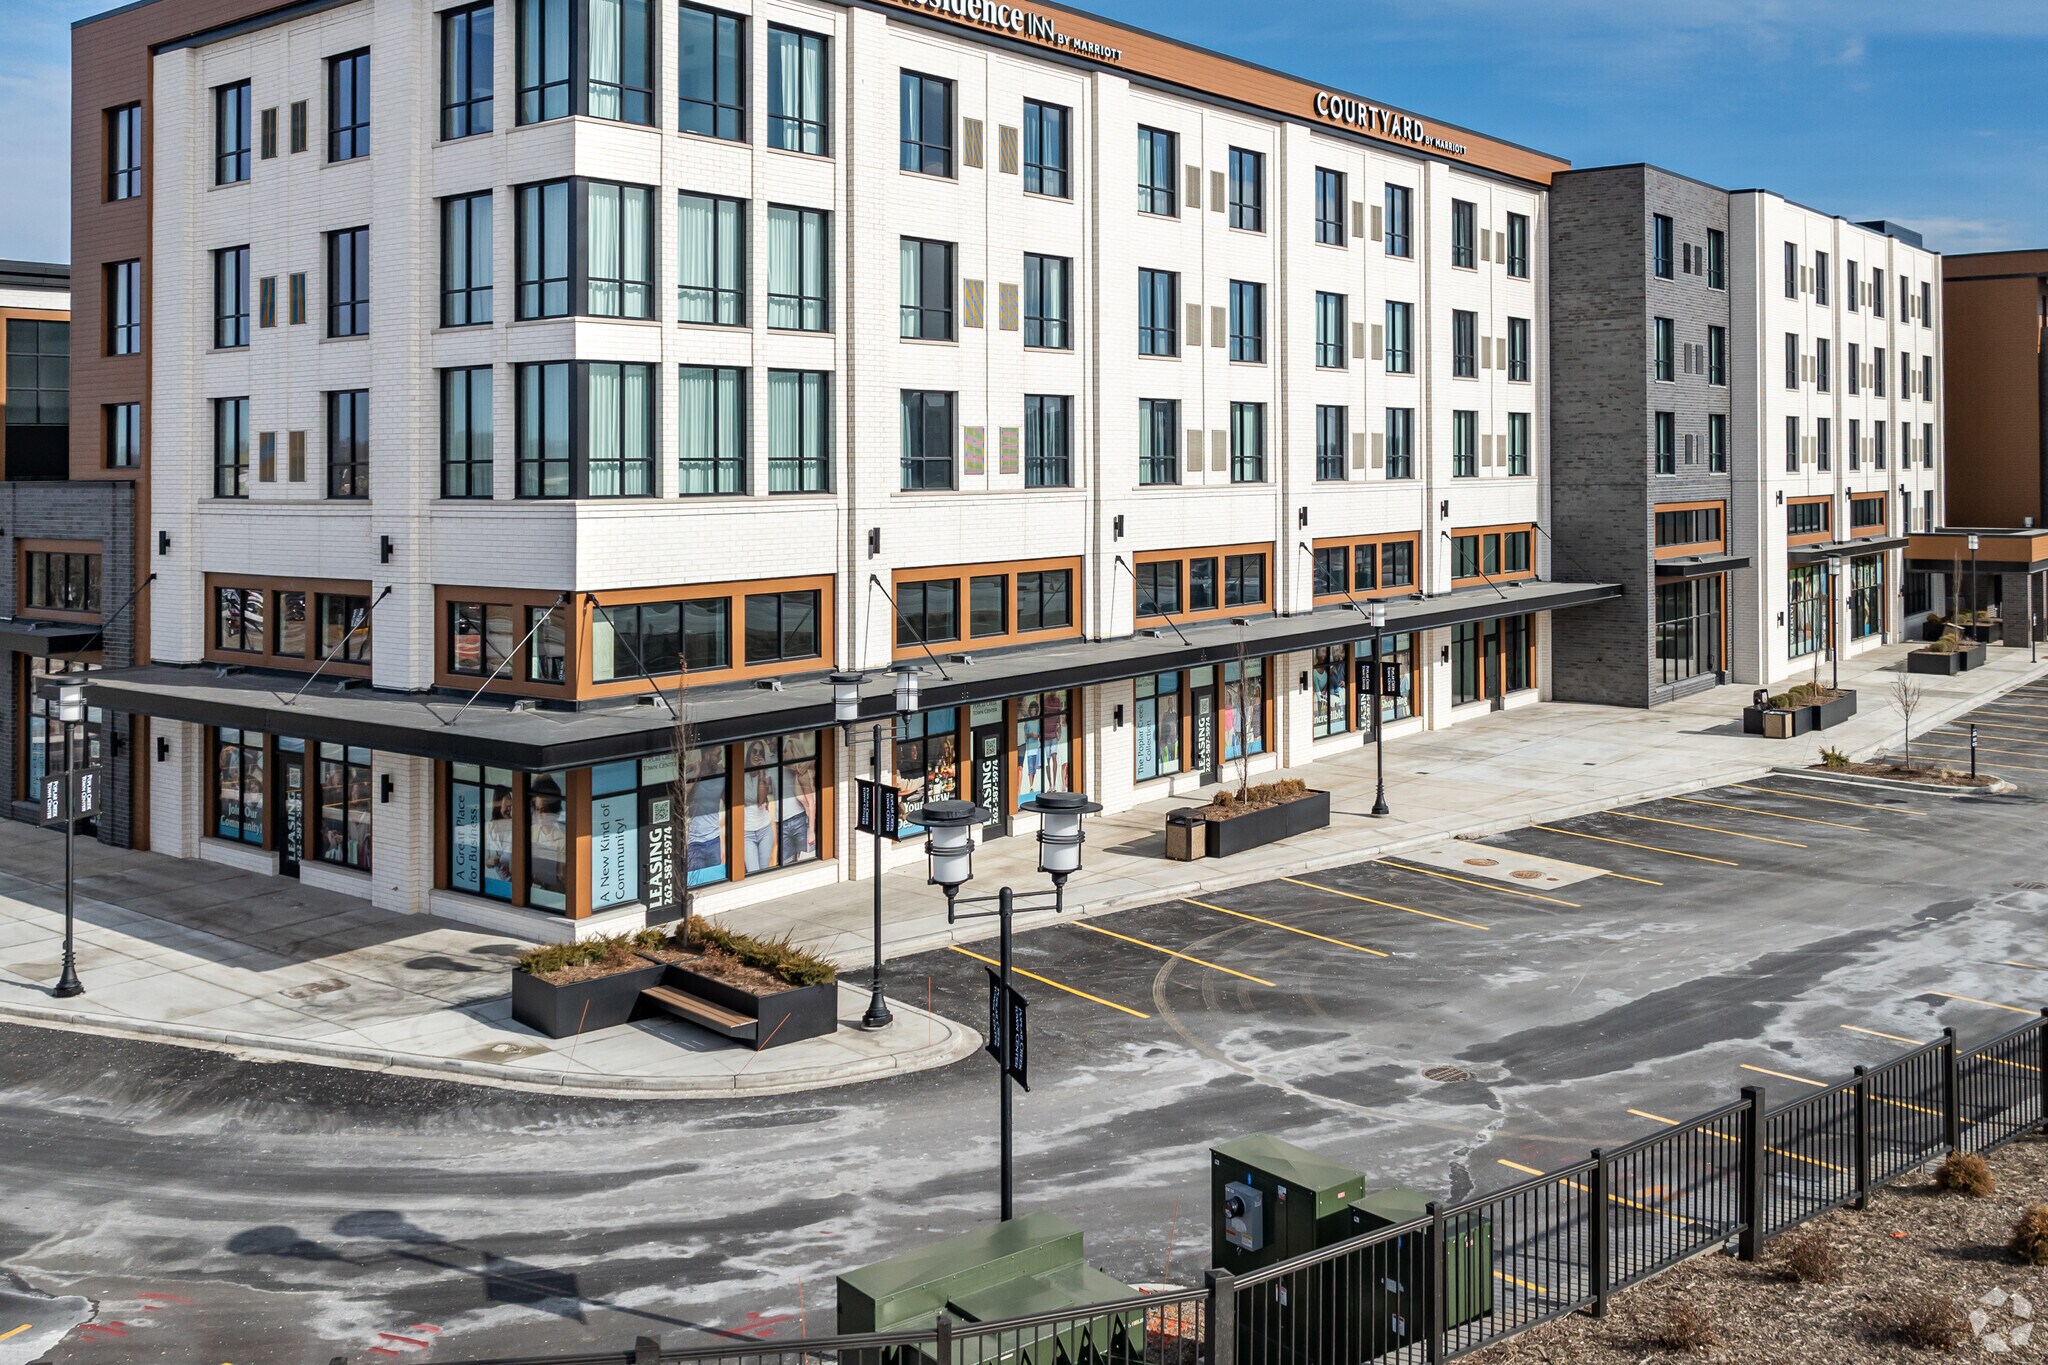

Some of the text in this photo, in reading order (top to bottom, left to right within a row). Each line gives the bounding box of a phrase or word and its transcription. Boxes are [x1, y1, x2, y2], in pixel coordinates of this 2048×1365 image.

[1028, 12, 1055, 41] INN
[1057, 33, 1122, 60] BY MARRIOTT
[1316, 91, 1424, 142] COURTYARD
[1425, 135, 1467, 155] BY MARRIOTT
[1137, 729, 1145, 757] Poplar
[1137, 758, 1145, 775] The
[1198, 717, 1206, 774] LEASING
[244, 806, 257, 819] Our
[903, 801, 923, 813] Your
[982, 760, 992, 826] LASING
[287, 792, 296, 861] LEASING
[456, 795, 466, 880] A Great Place
[468, 805, 478, 883] for Business.
[600, 803, 611, 902] A New Kind of
[615, 817, 627, 900] Community!
[649, 827, 663, 909] LEASING
[664, 826, 672, 905] 262-587-5974
